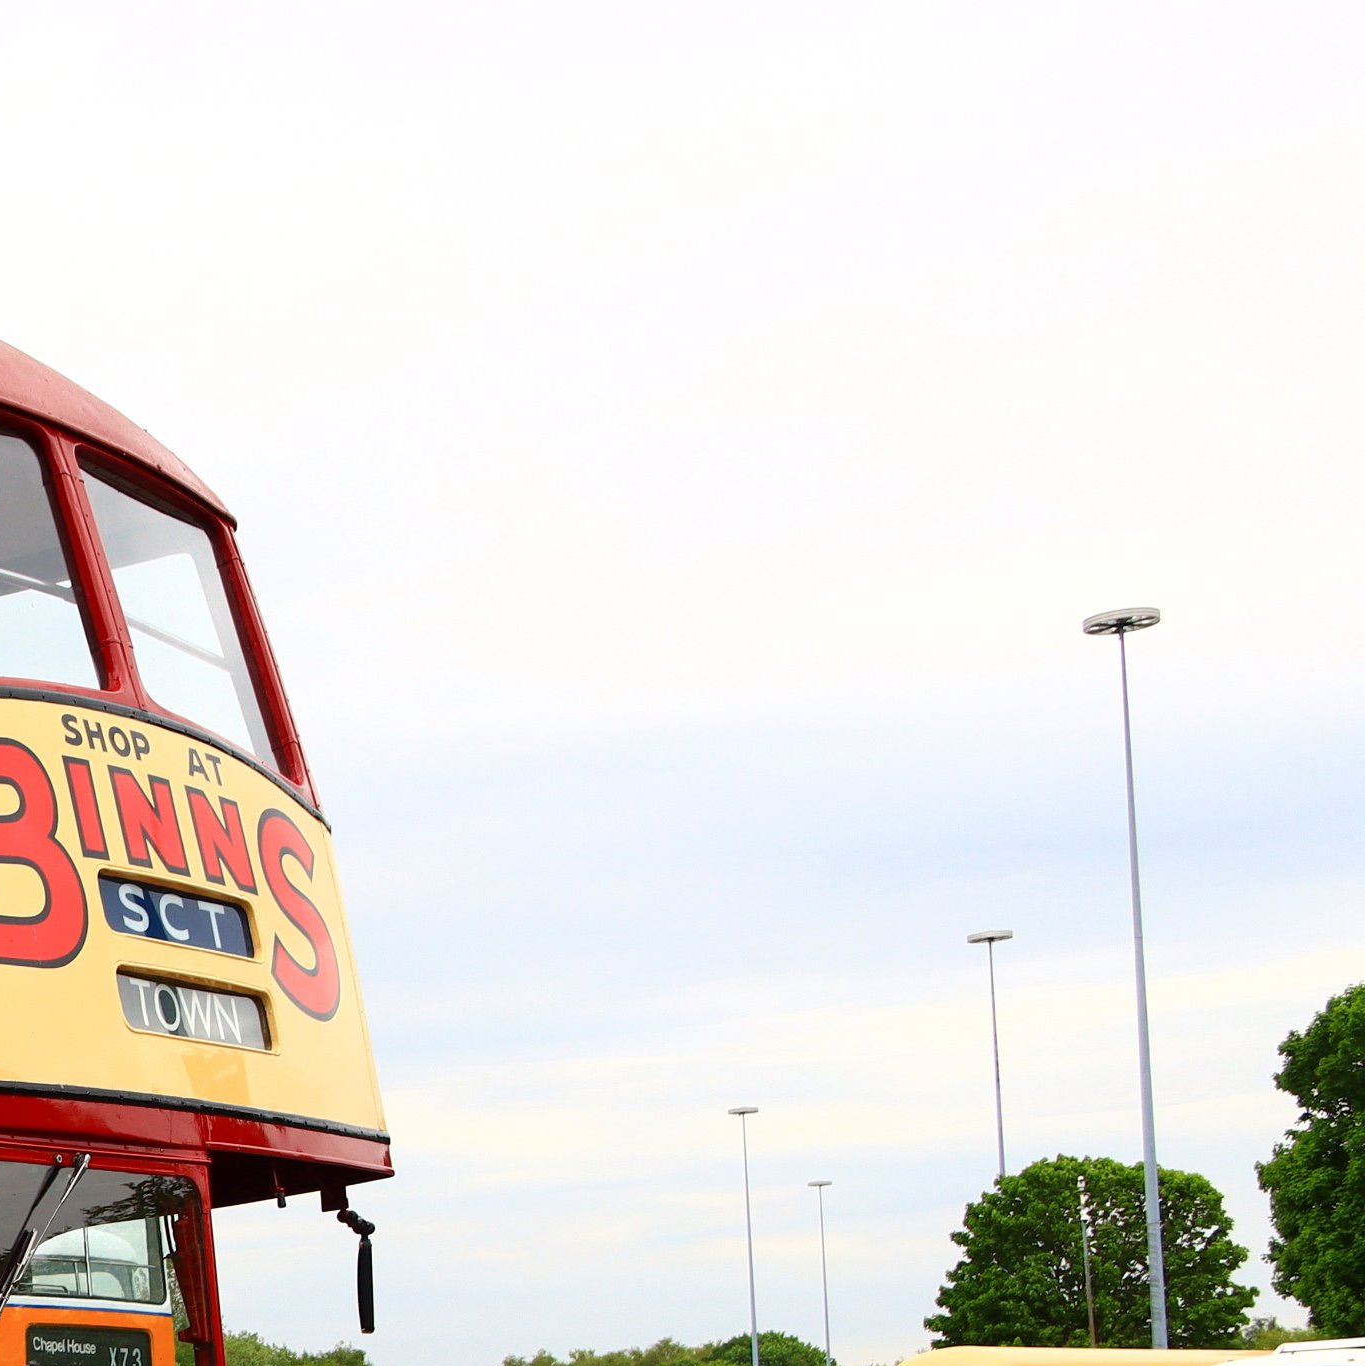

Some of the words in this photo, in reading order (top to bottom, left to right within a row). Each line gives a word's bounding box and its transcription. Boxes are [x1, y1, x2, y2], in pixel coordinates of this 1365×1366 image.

[61, 713, 150, 761] SHOP
[187, 747, 222, 787] AT
[117, 883, 225, 949] SCT
[128, 977, 243, 1045] TOWN
[33, 1336, 65, 1355] Chapel
[67, 1339, 96, 1354] House
